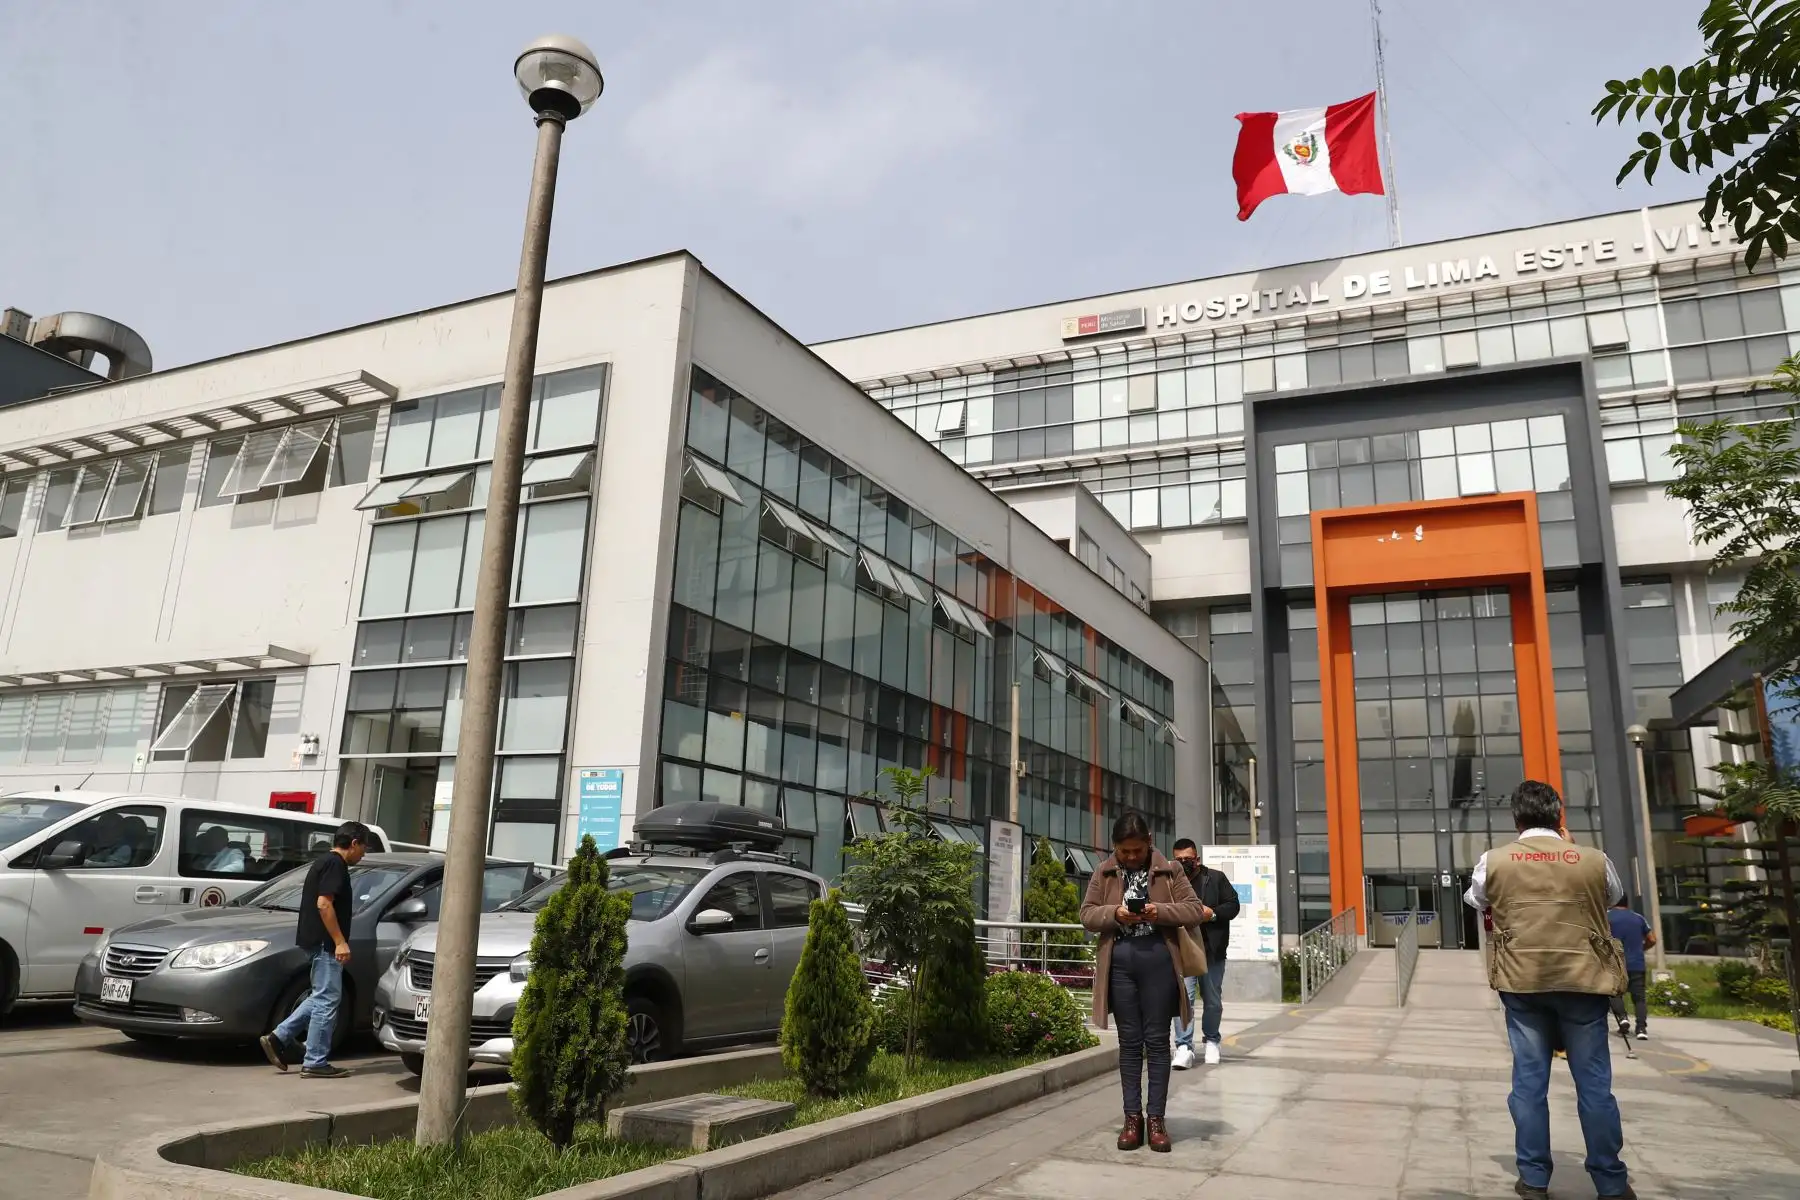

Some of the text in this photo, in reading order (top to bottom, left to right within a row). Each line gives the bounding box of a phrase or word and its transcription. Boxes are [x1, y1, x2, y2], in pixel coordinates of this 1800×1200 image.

[1157, 281, 1329, 327] HOSPITAL
[1343, 270, 1391, 300] DE
[1404, 256, 1499, 290] LIMA
[1515, 238, 1617, 273] ESTE
[1510, 853, 1523, 861] TV
